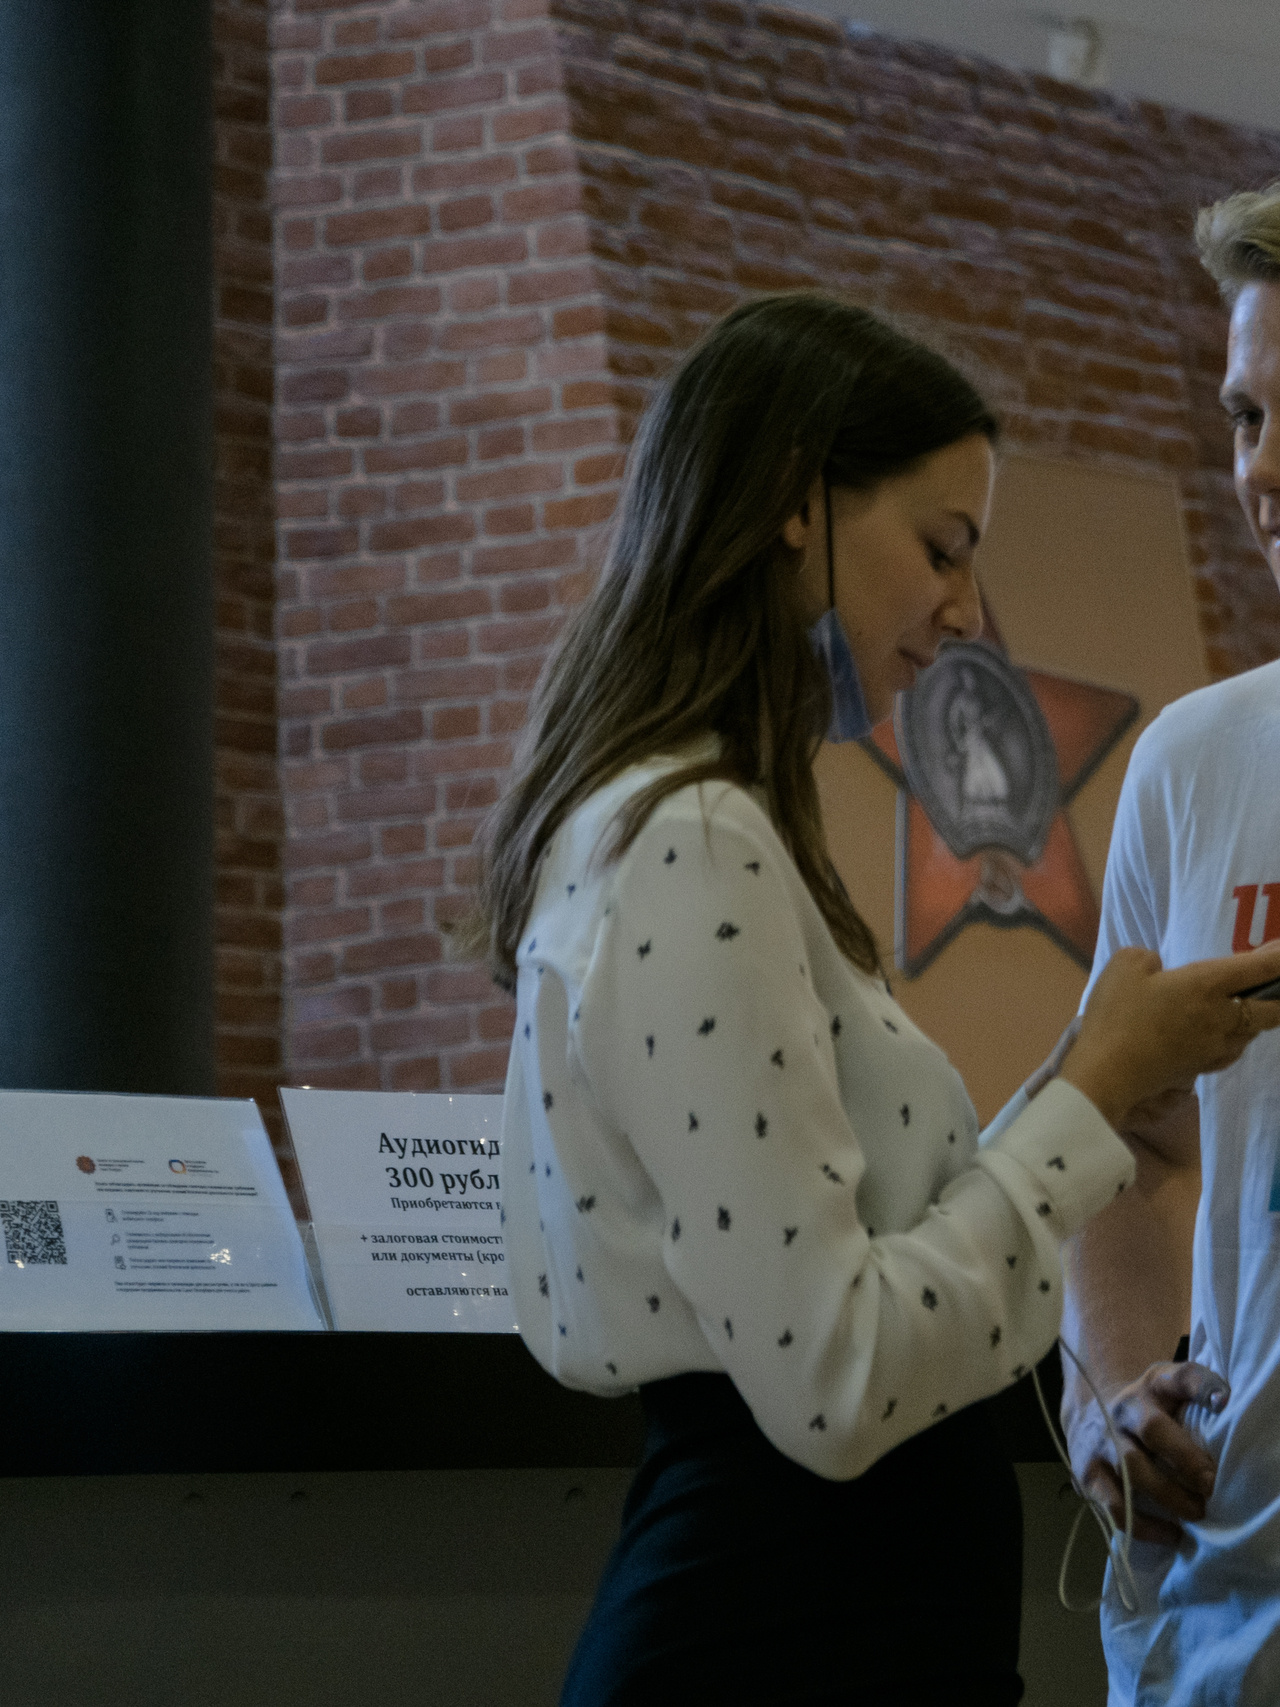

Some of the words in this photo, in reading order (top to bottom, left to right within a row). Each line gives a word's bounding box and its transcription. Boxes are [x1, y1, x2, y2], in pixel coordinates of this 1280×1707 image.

[378, 1132, 500, 1160] Аудиогид
[385, 1167, 434, 1188] 300
[439, 1168, 500, 1195] рубл
[390, 1197, 493, 1211] Приобретаются
[371, 1234, 439, 1244] залоговая
[371, 1252, 397, 1262] или
[401, 1252, 474, 1264] документы
[476, 1250, 505, 1264] (кро
[406, 1286, 490, 1297] оставляются
[494, 1287, 509, 1297] на
